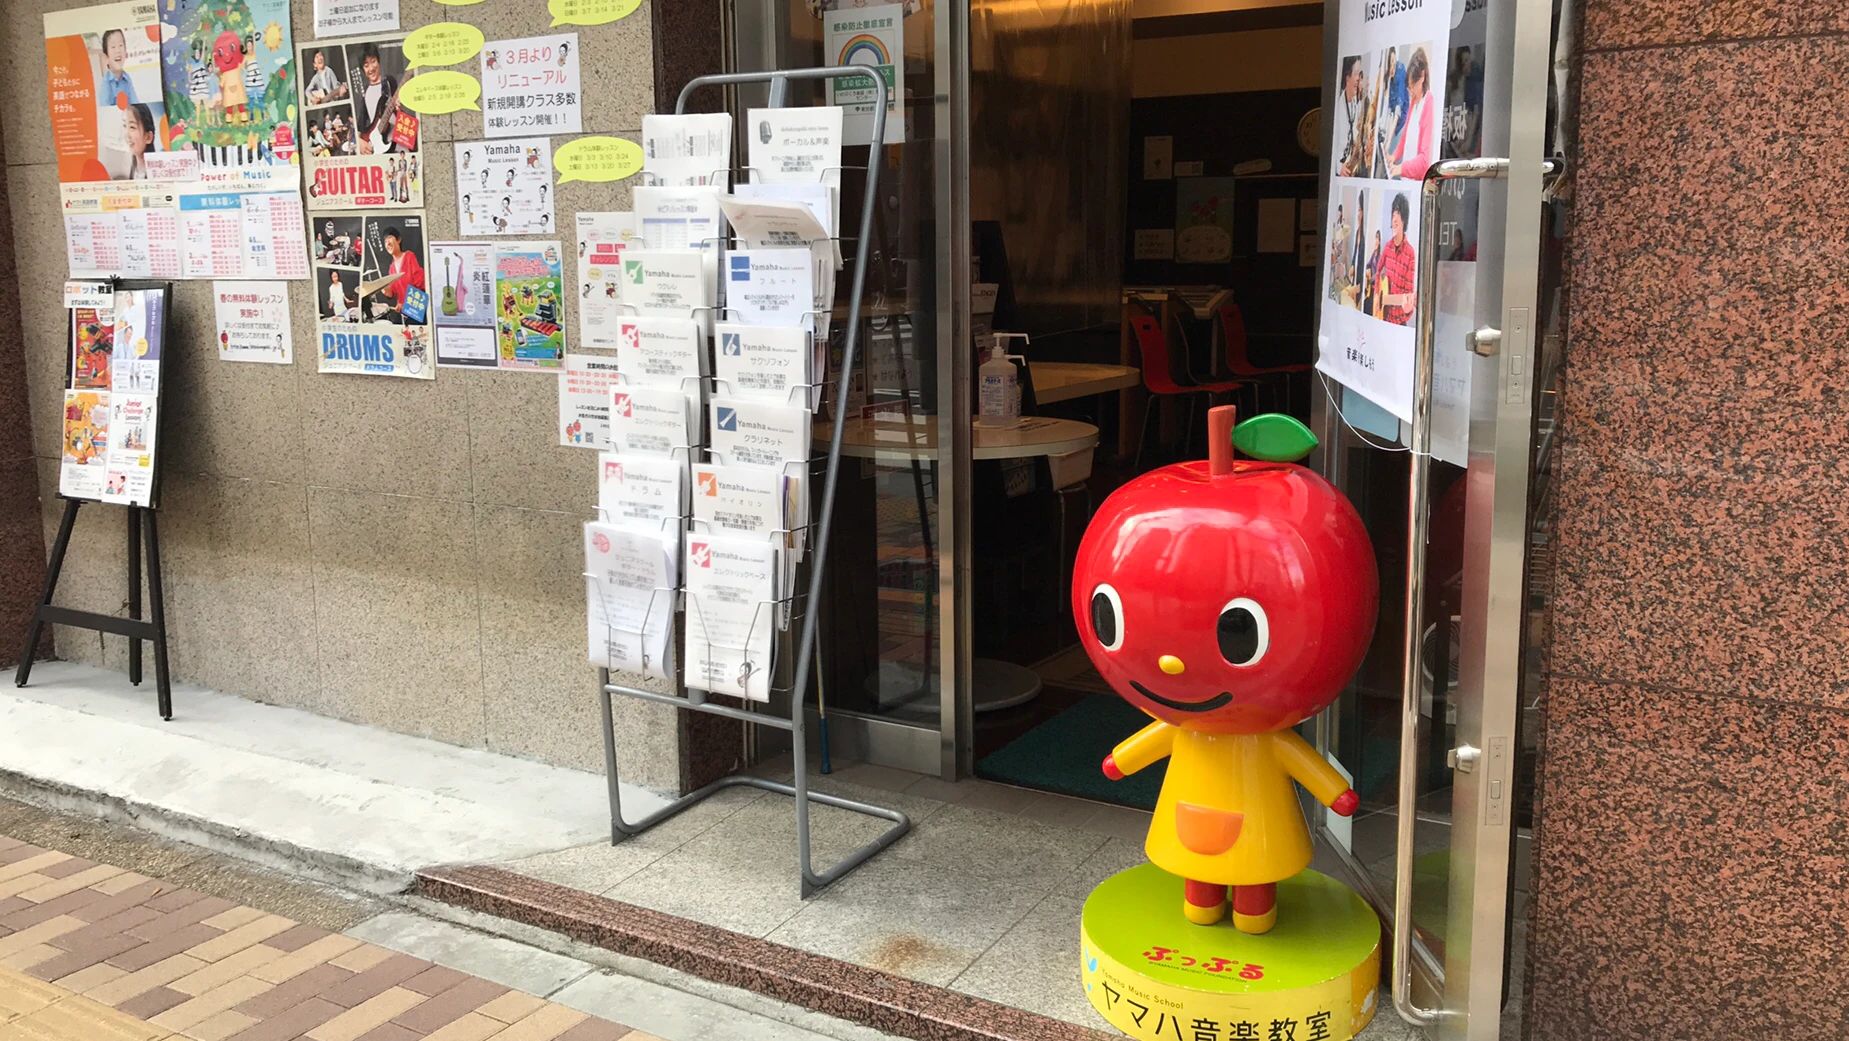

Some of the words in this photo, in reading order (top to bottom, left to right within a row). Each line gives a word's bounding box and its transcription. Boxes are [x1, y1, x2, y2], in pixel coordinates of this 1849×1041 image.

[834, 18, 893, 32] 感染防止徹底宣言
[498, 70, 567, 89] リニューアル
[488, 92, 576, 110] 新規開講クラス多数
[484, 144, 521, 155] Yamaha
[201, 173, 227, 182] Power
[244, 170, 271, 179] Music
[314, 166, 385, 196] GUITAR
[473, 272, 481, 282] 炎
[645, 270, 670, 278] Yamaha
[66, 286, 112, 295] ロボット教室
[220, 294, 284, 304] 春の無料体験レッスン
[322, 333, 394, 363] DRUMS
[743, 344, 771, 352] Yamaha
[633, 403, 657, 412] Yamaha
[738, 420, 766, 430] Yamaha
[745, 435, 783, 446] クラリネット
[624, 472, 648, 481] Yamaha
[719, 482, 745, 492] Yamaha
[712, 550, 739, 560] Yamaha
[1142, 946, 1265, 981] ぷっぷる
[1103, 968, 1126, 989] Yamaha
[1129, 984, 1150, 1001] Music
[1154, 995, 1184, 1010] School
[1102, 981, 1331, 1041] ヤマハ音楽教室
